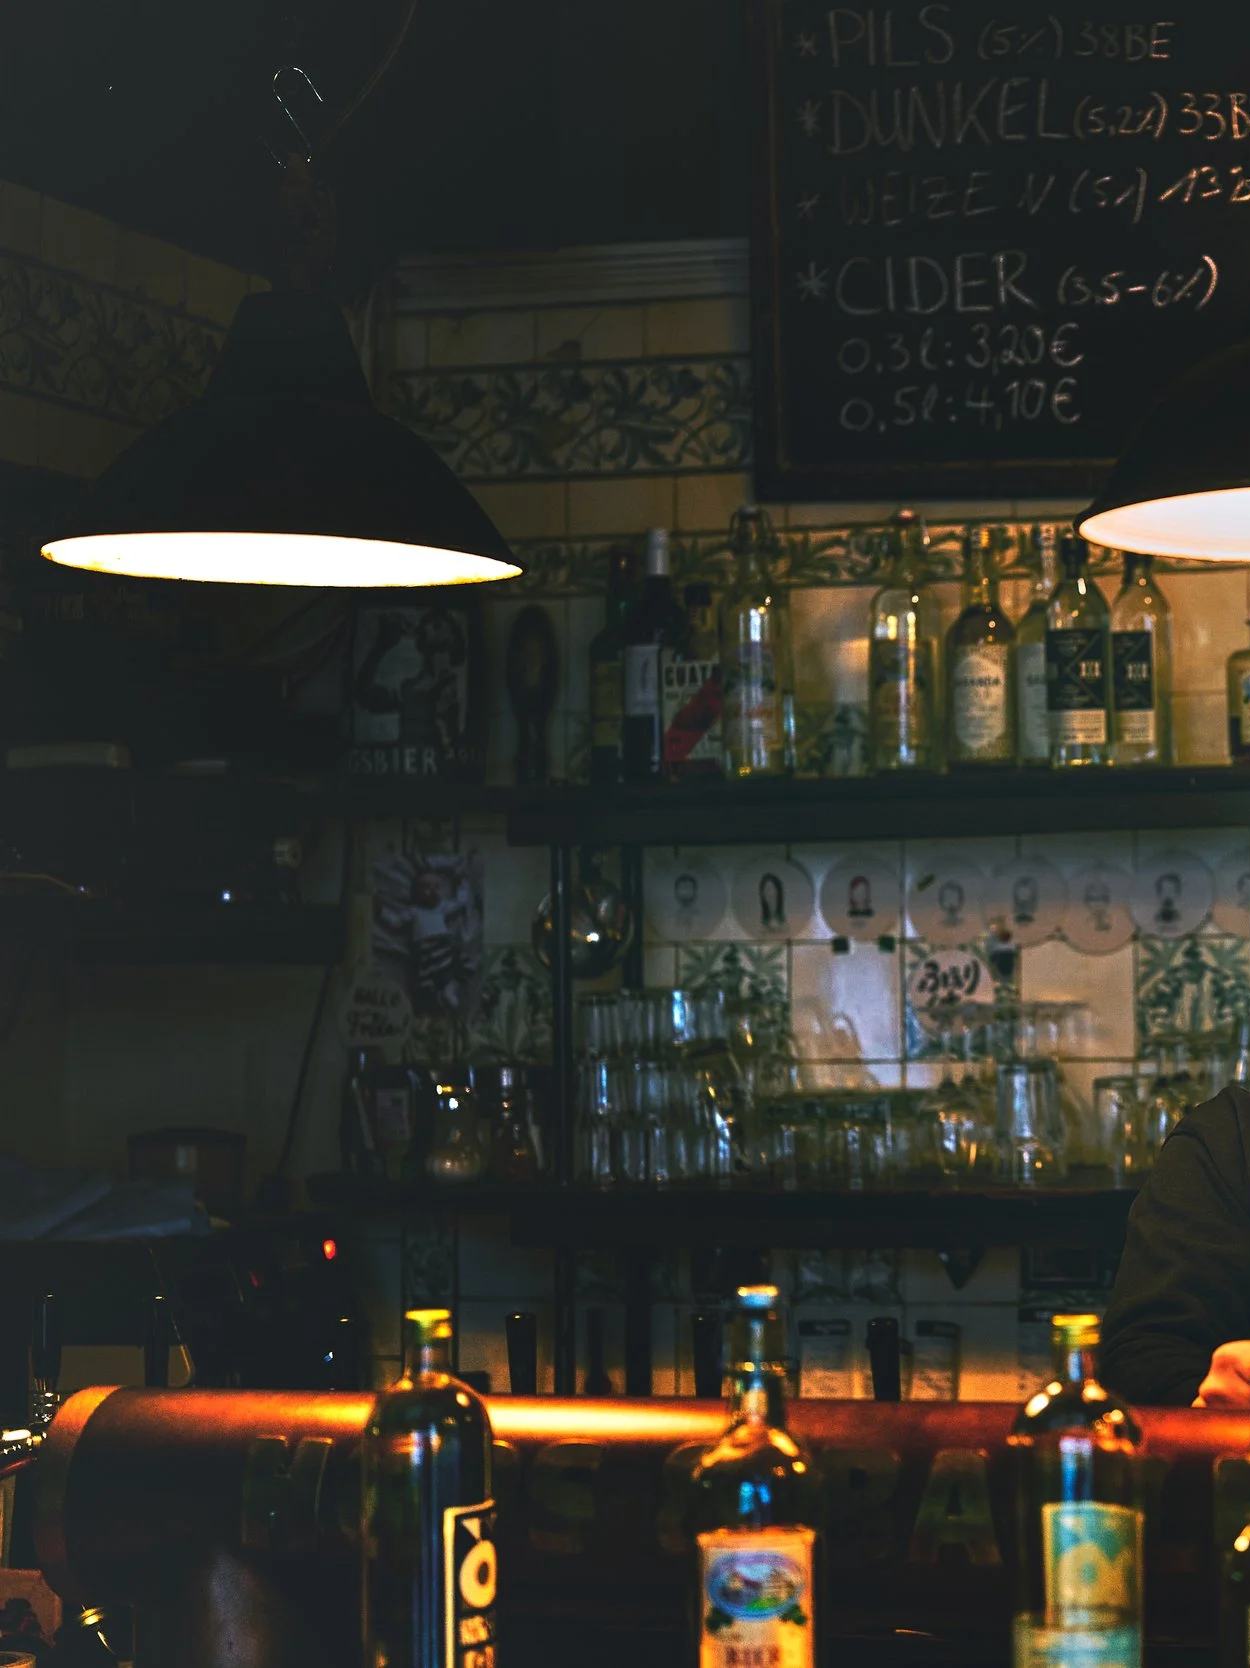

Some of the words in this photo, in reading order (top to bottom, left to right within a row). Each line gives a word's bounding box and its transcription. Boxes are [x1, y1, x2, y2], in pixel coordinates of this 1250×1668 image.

[827, 5, 956, 67] PILS
[826, 76, 1073, 155] DUNKEL
[835, 251, 1038, 314] CIDER
